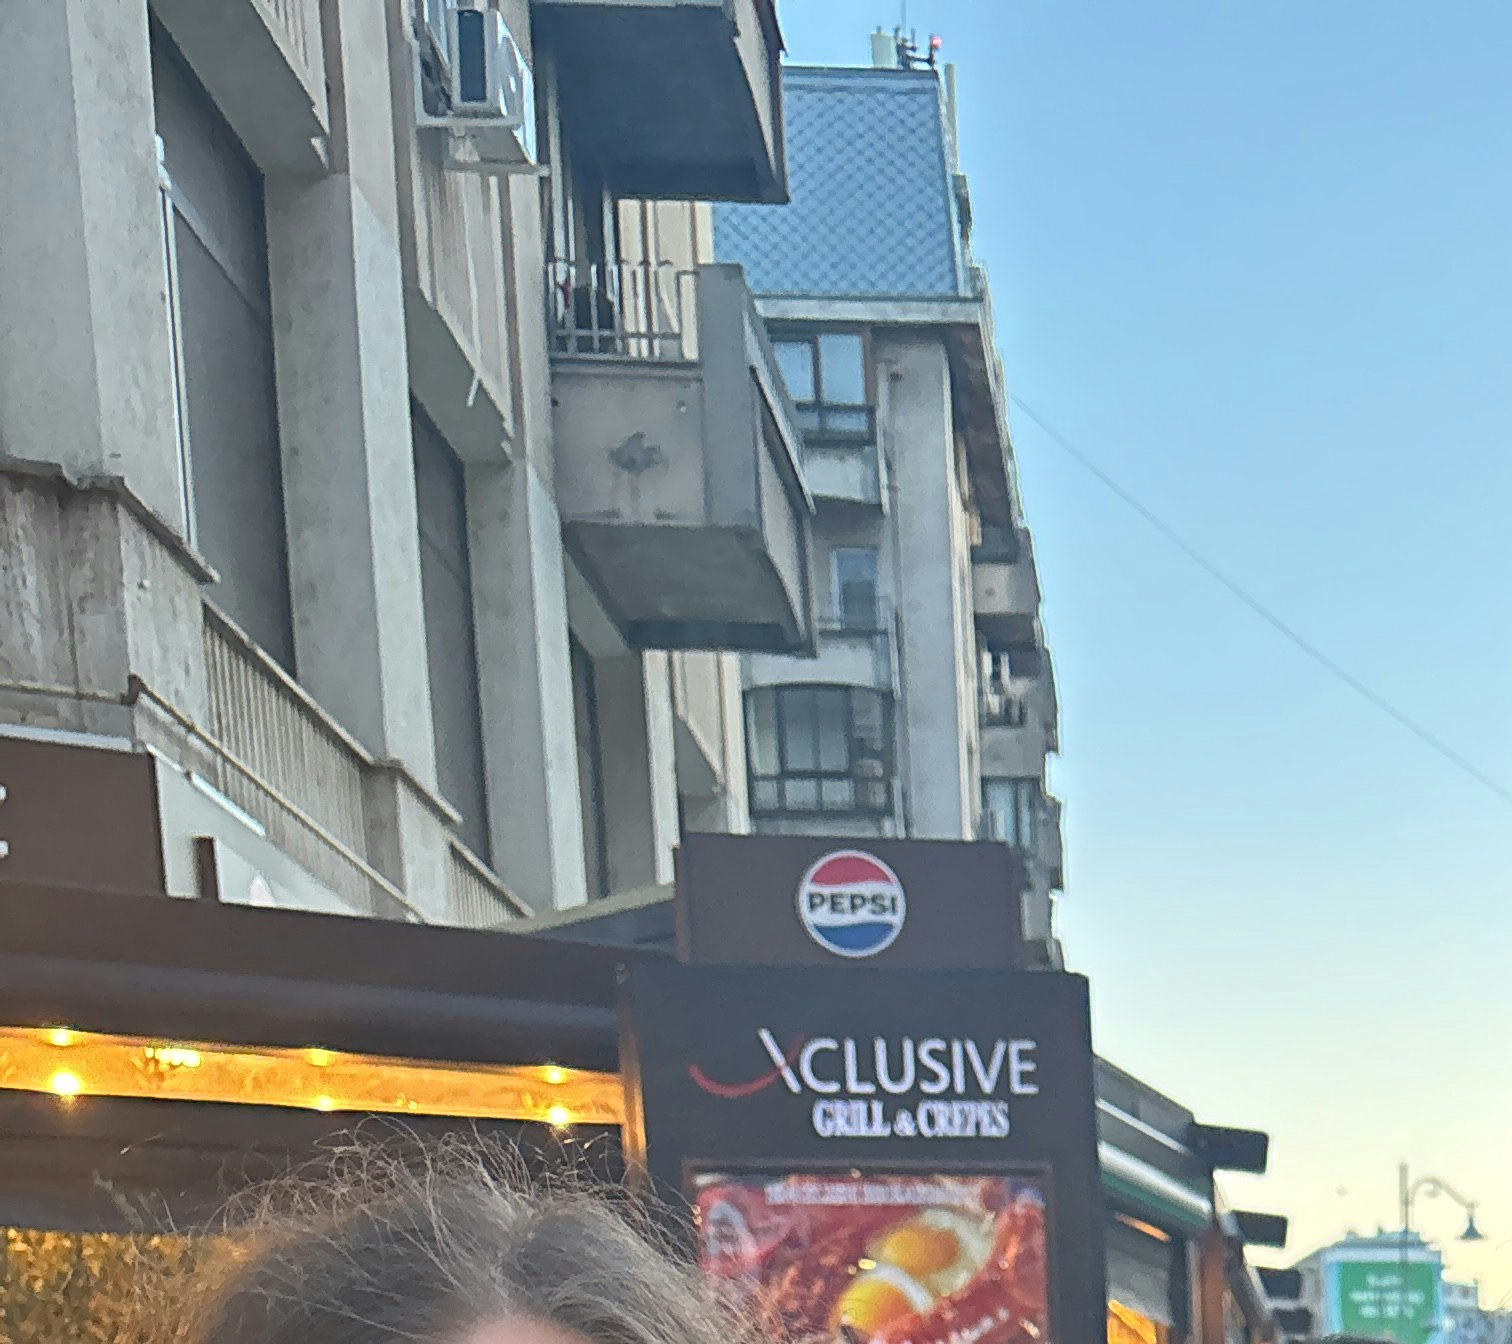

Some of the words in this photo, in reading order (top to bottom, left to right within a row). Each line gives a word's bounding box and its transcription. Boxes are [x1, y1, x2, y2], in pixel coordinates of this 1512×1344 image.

[807, 891, 899, 915] PEPSI
[688, 1027, 1040, 1098] XCLUSIVE
[812, 1100, 892, 1137] GRILL
[894, 1108, 918, 1137] &
